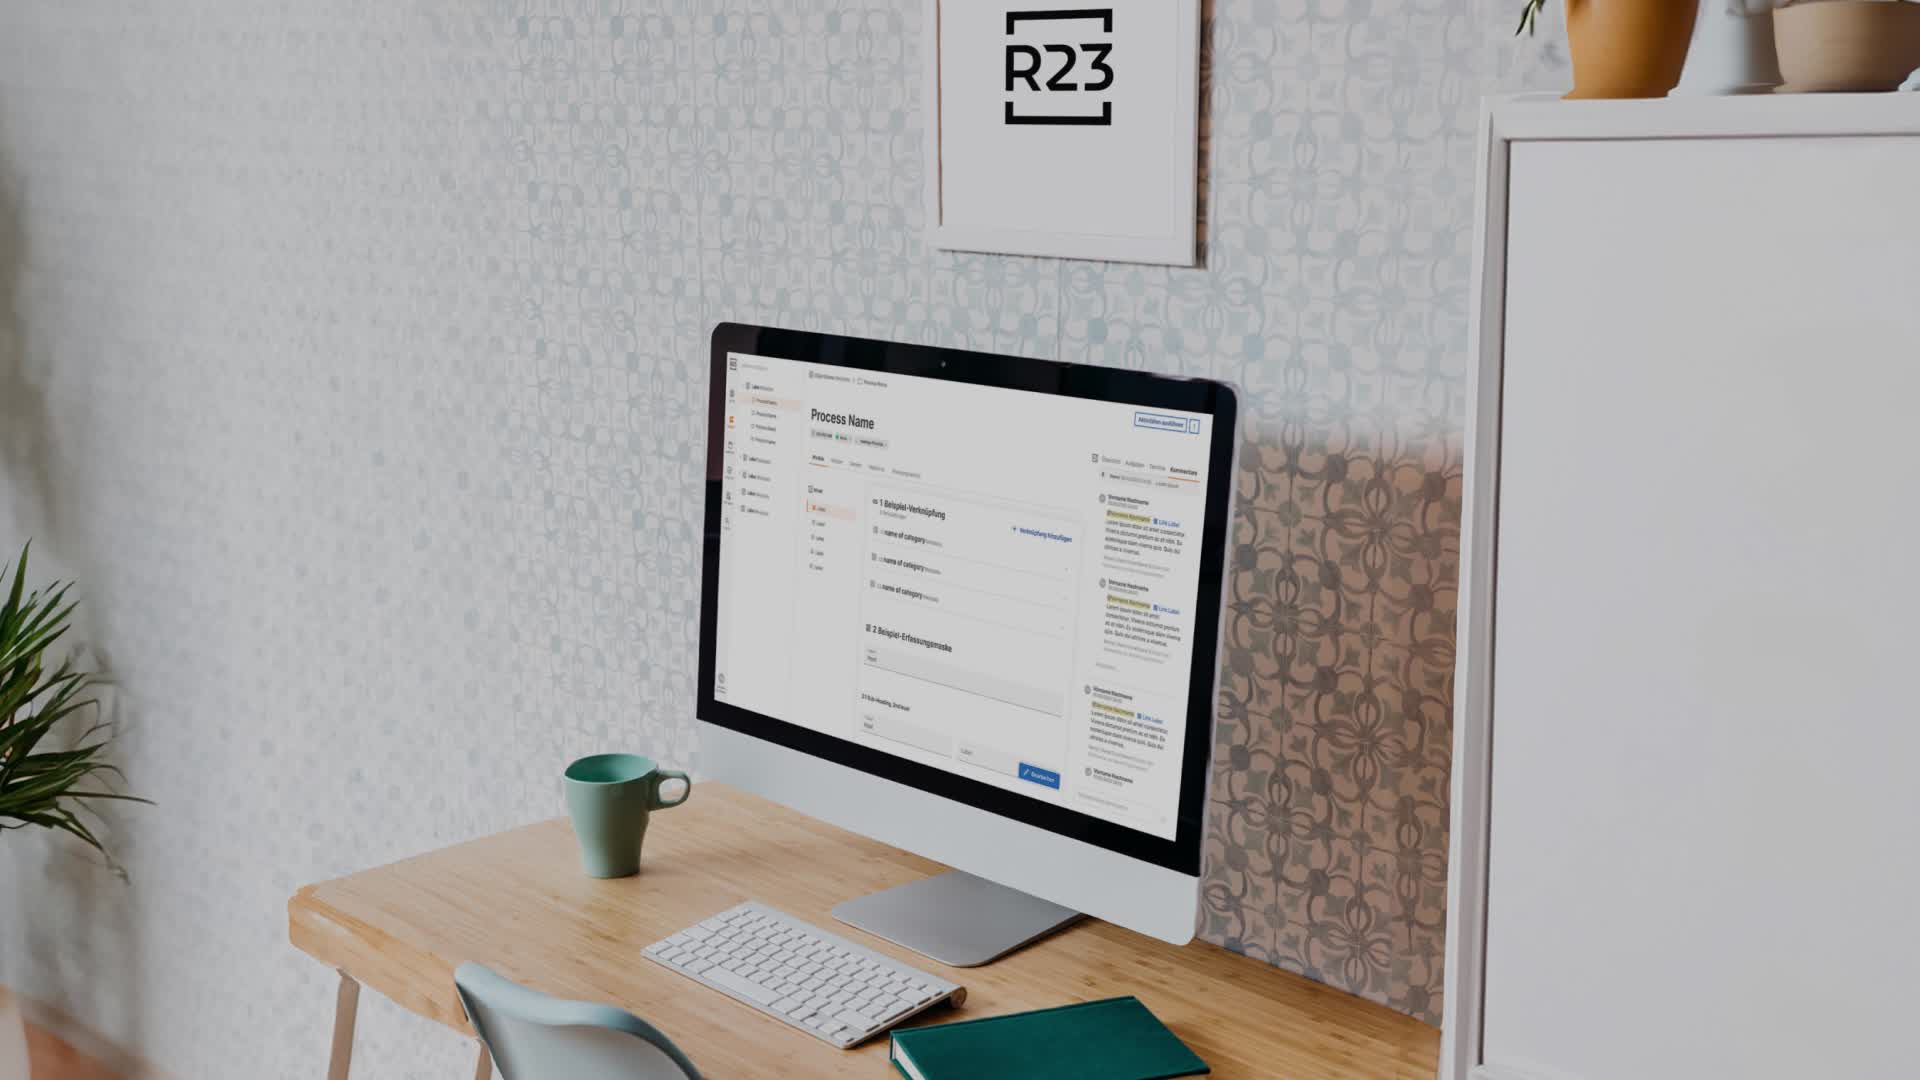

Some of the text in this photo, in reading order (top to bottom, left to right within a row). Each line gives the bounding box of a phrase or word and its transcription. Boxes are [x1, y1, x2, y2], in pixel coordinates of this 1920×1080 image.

[1005, 43, 1114, 91] R23
[811, 408, 875, 429] Process Name
[884, 530, 897, 539] name
[904, 534, 926, 544] category
[883, 557, 896, 565] name
[903, 562, 925, 572] category
[882, 584, 895, 592] name
[901, 589, 923, 600] category
